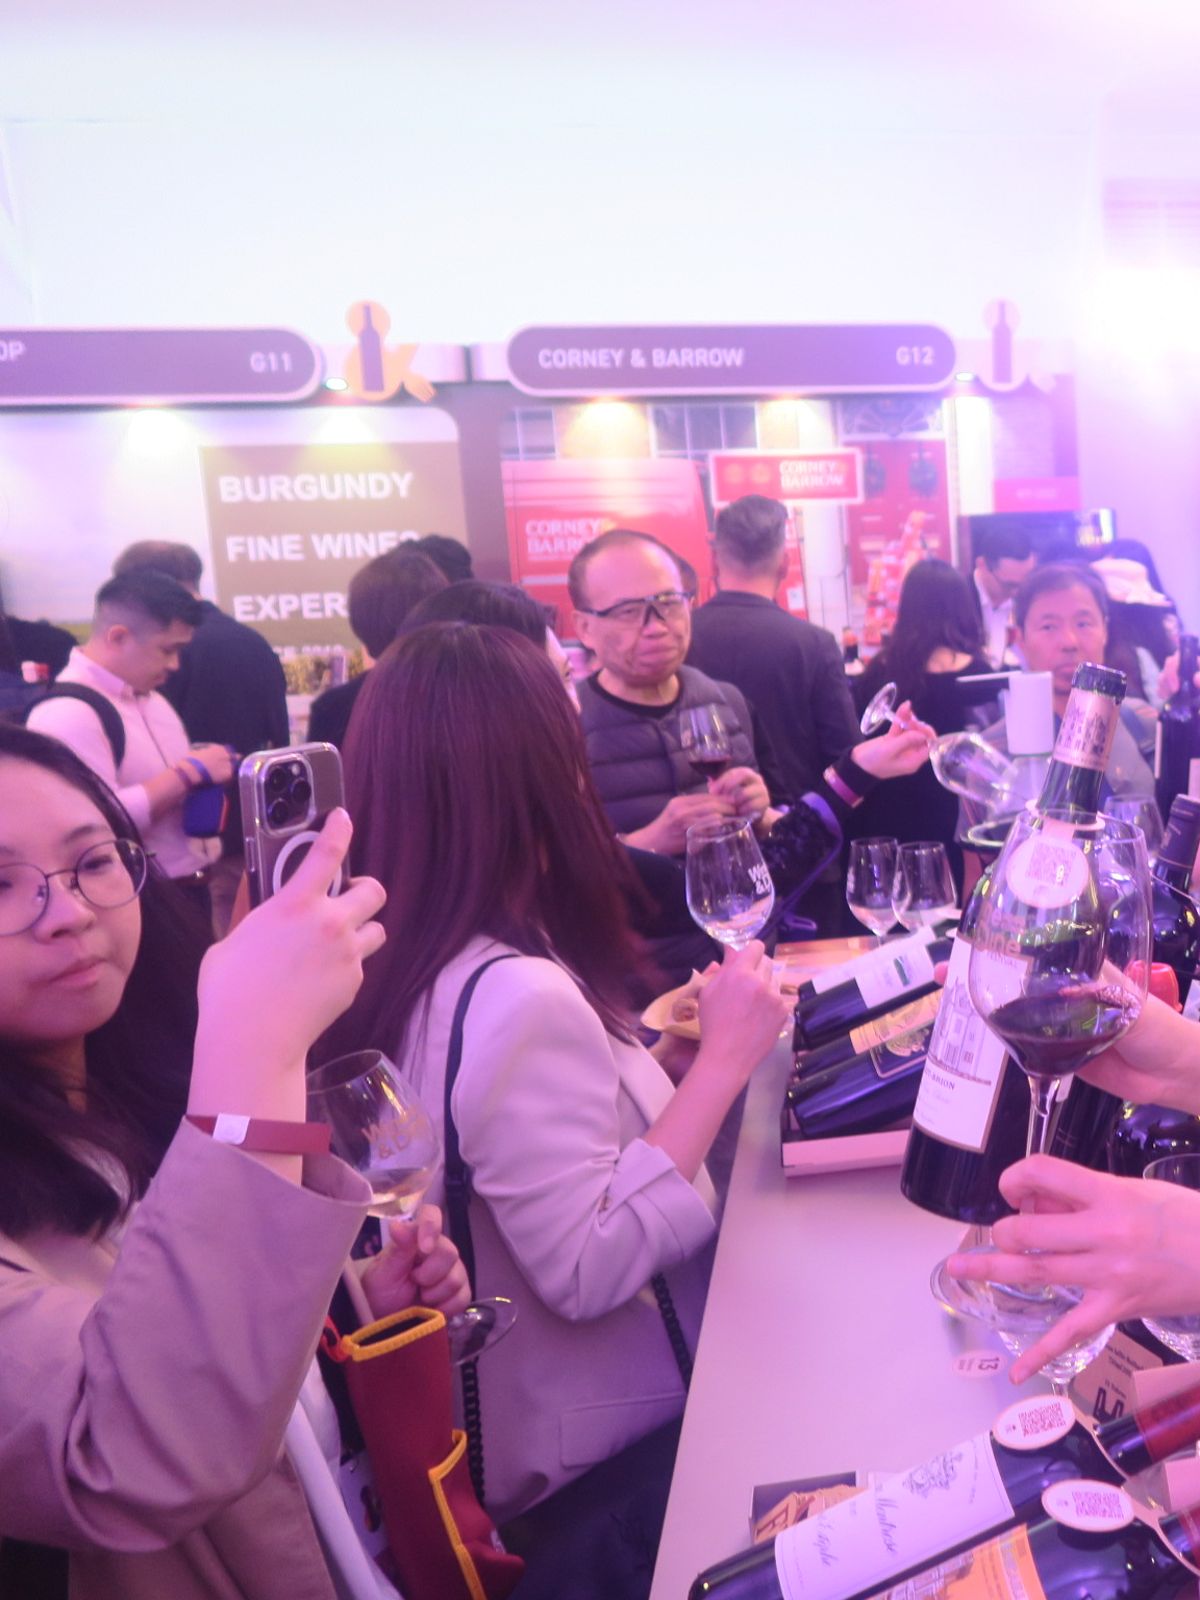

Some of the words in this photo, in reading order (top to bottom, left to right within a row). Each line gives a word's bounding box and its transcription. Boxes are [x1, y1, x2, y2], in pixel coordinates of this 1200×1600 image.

[250, 352, 292, 372] G11
[538, 347, 624, 369] CORNEY
[630, 348, 648, 369] &
[652, 347, 744, 368] BARROW
[896, 346, 936, 366] G12
[218, 472, 413, 502] BURGUNDY
[226, 533, 304, 562] FINE
